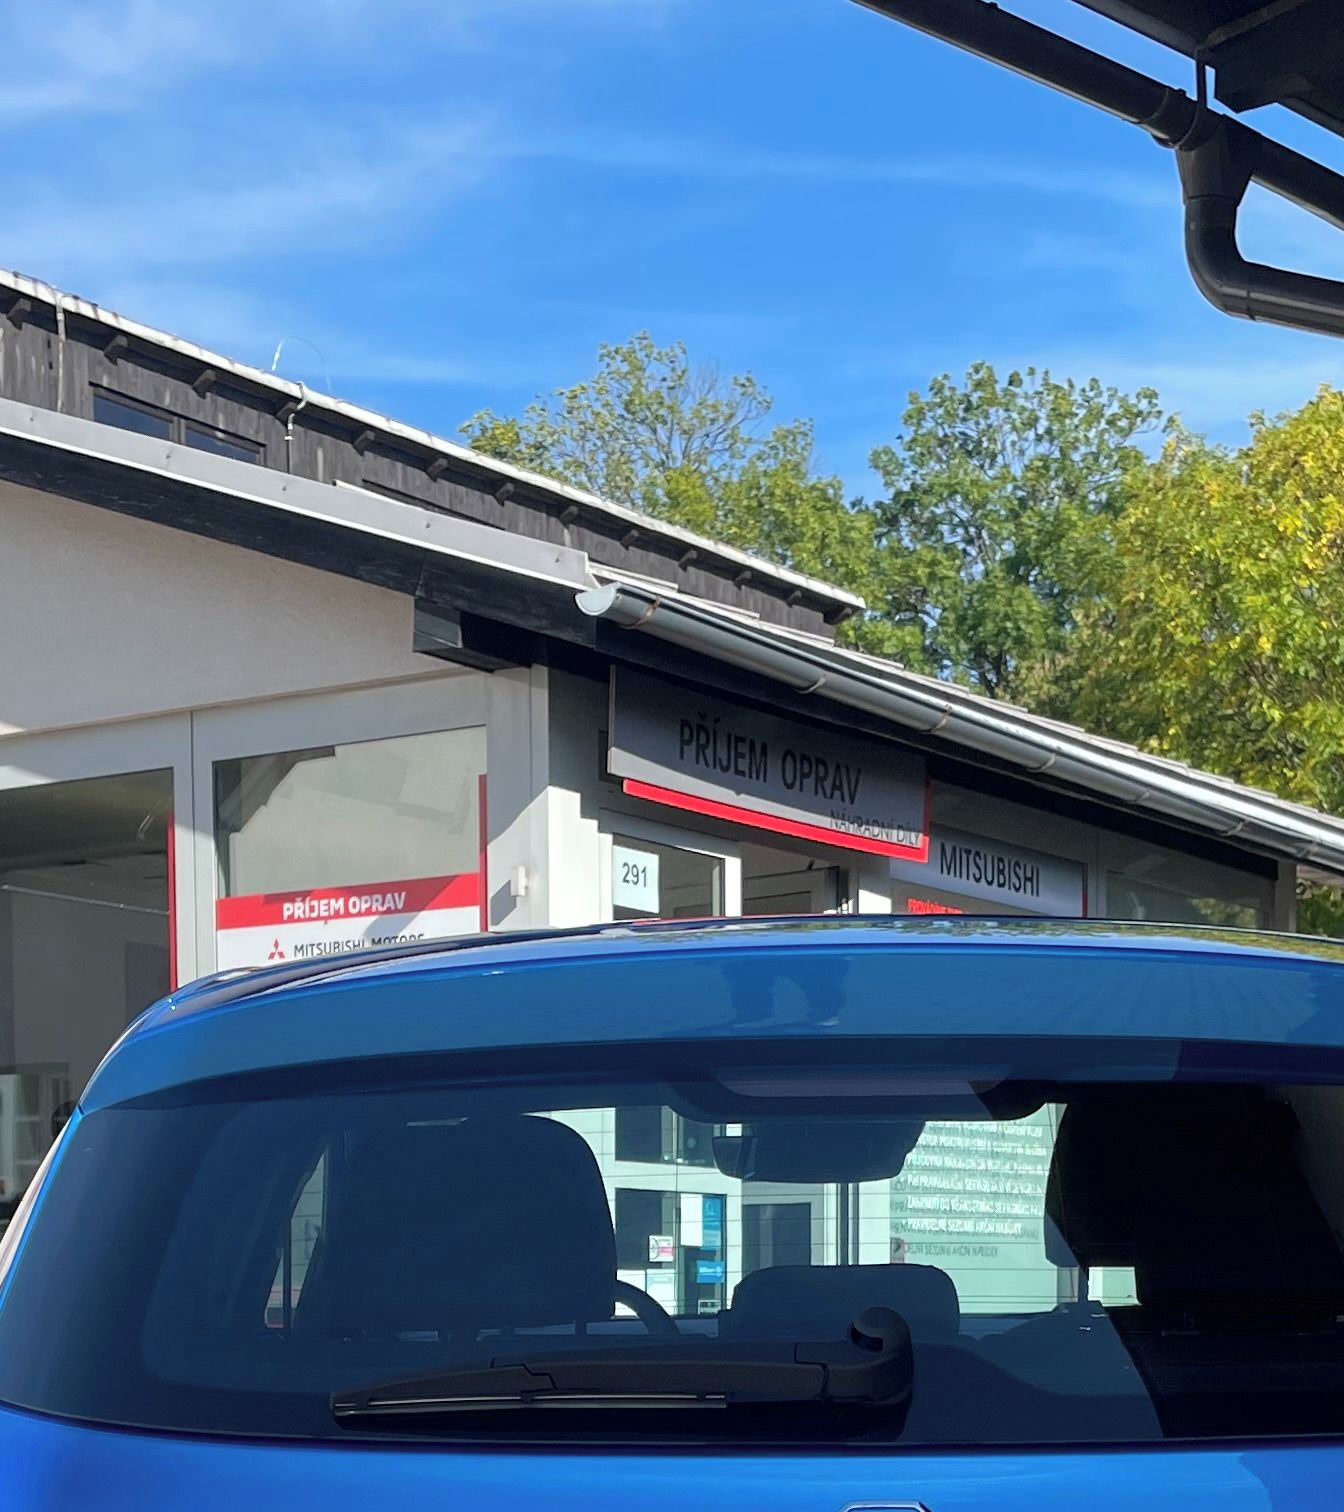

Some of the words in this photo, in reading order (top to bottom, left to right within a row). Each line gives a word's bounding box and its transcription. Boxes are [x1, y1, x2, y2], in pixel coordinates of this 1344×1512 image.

[678, 712, 769, 784] PŘÍJEM
[782, 748, 862, 806] OPRAV
[830, 808, 894, 841] NÁHRADNÍ
[621, 862, 649, 889] 291
[940, 842, 1041, 898] MITSUBISHI
[282, 896, 345, 921] PŘÍJEM
[348, 891, 407, 914] OPRAV
